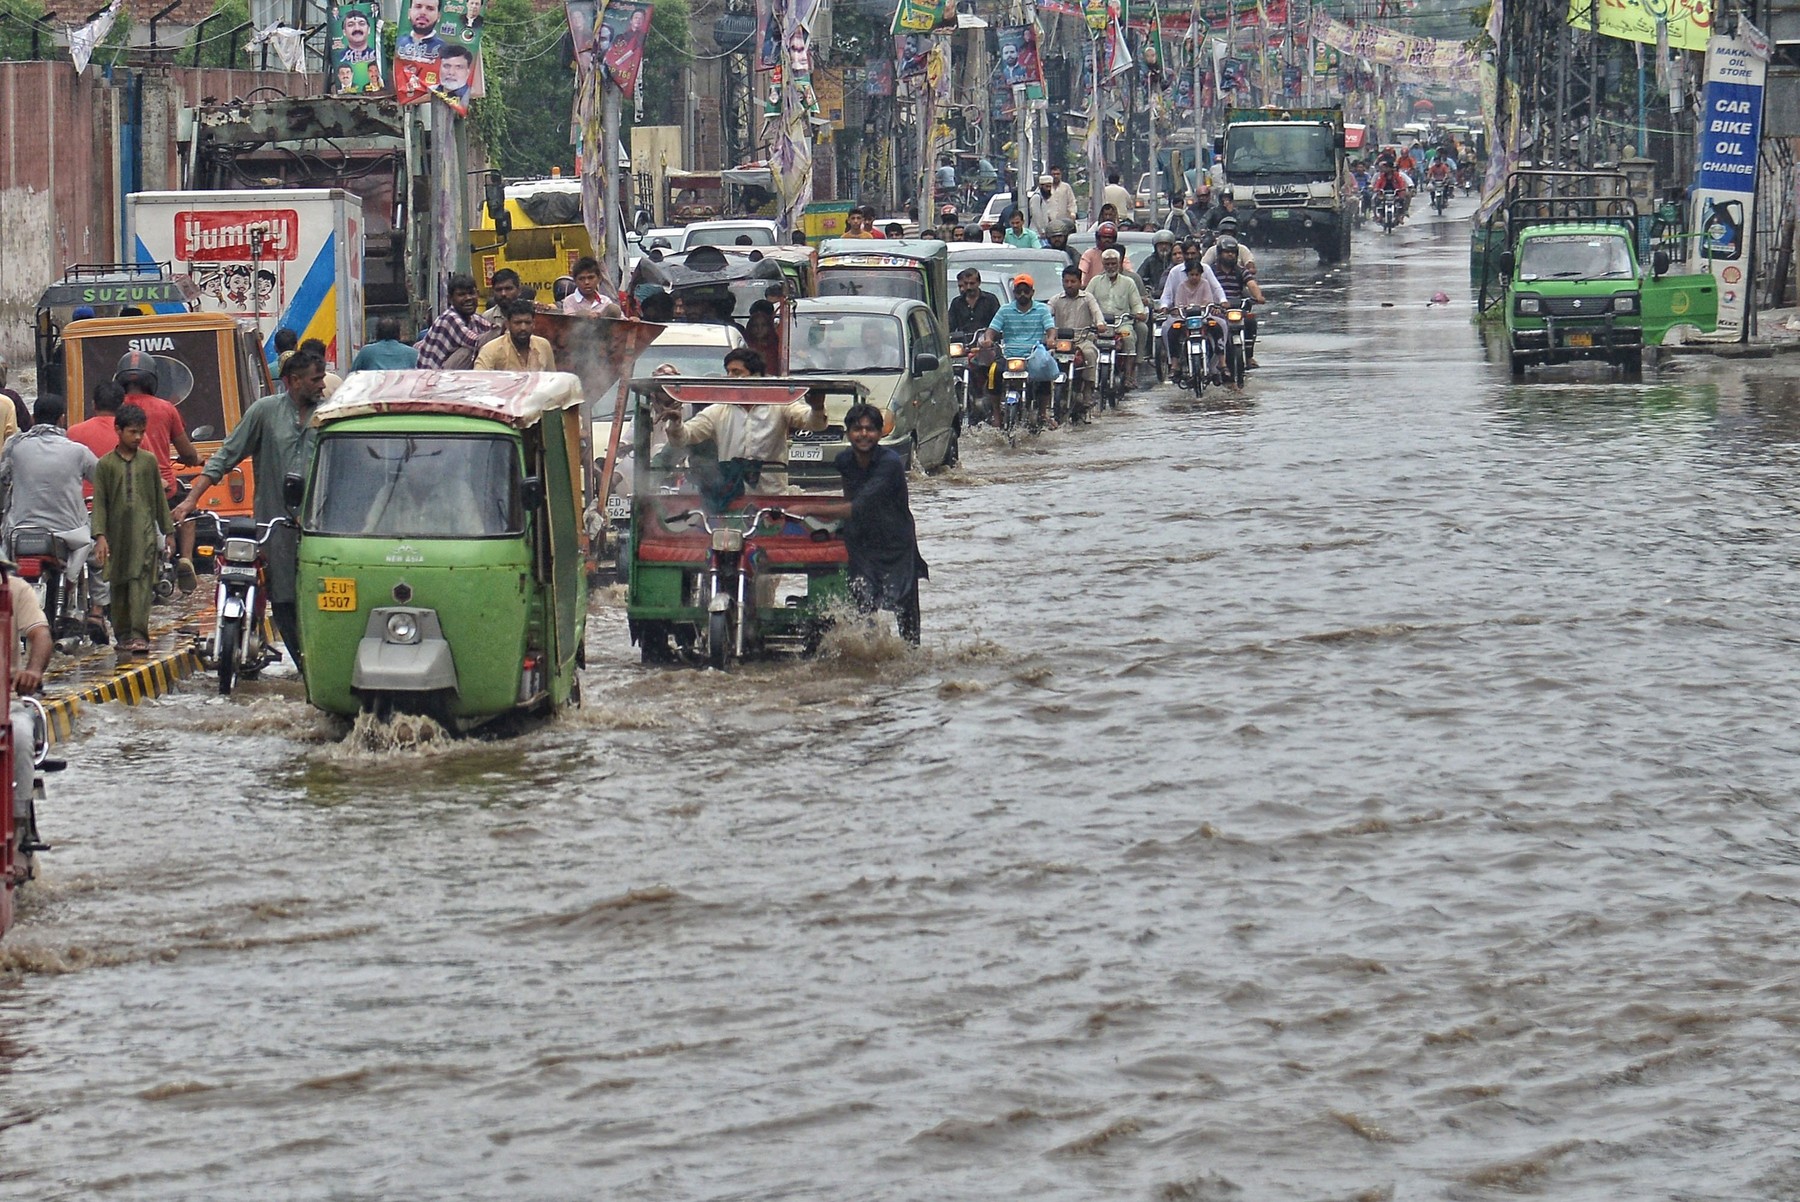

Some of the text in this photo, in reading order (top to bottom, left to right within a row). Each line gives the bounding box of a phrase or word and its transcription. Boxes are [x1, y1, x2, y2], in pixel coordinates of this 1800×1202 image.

[1728, 58, 1745, 67] OIL
[1719, 67, 1753, 77] STORE
[1715, 99, 1751, 114] CAR
[1710, 120, 1753, 135] BIKE
[1715, 141, 1744, 156] OIL
[1702, 161, 1753, 175] CHANGE
[184, 218, 288, 253] Yummy
[82, 286, 171, 303] SUZUKI
[128, 336, 175, 352] SIWA
[807, 450, 820, 459] 577
[322, 596, 350, 608] 1507
